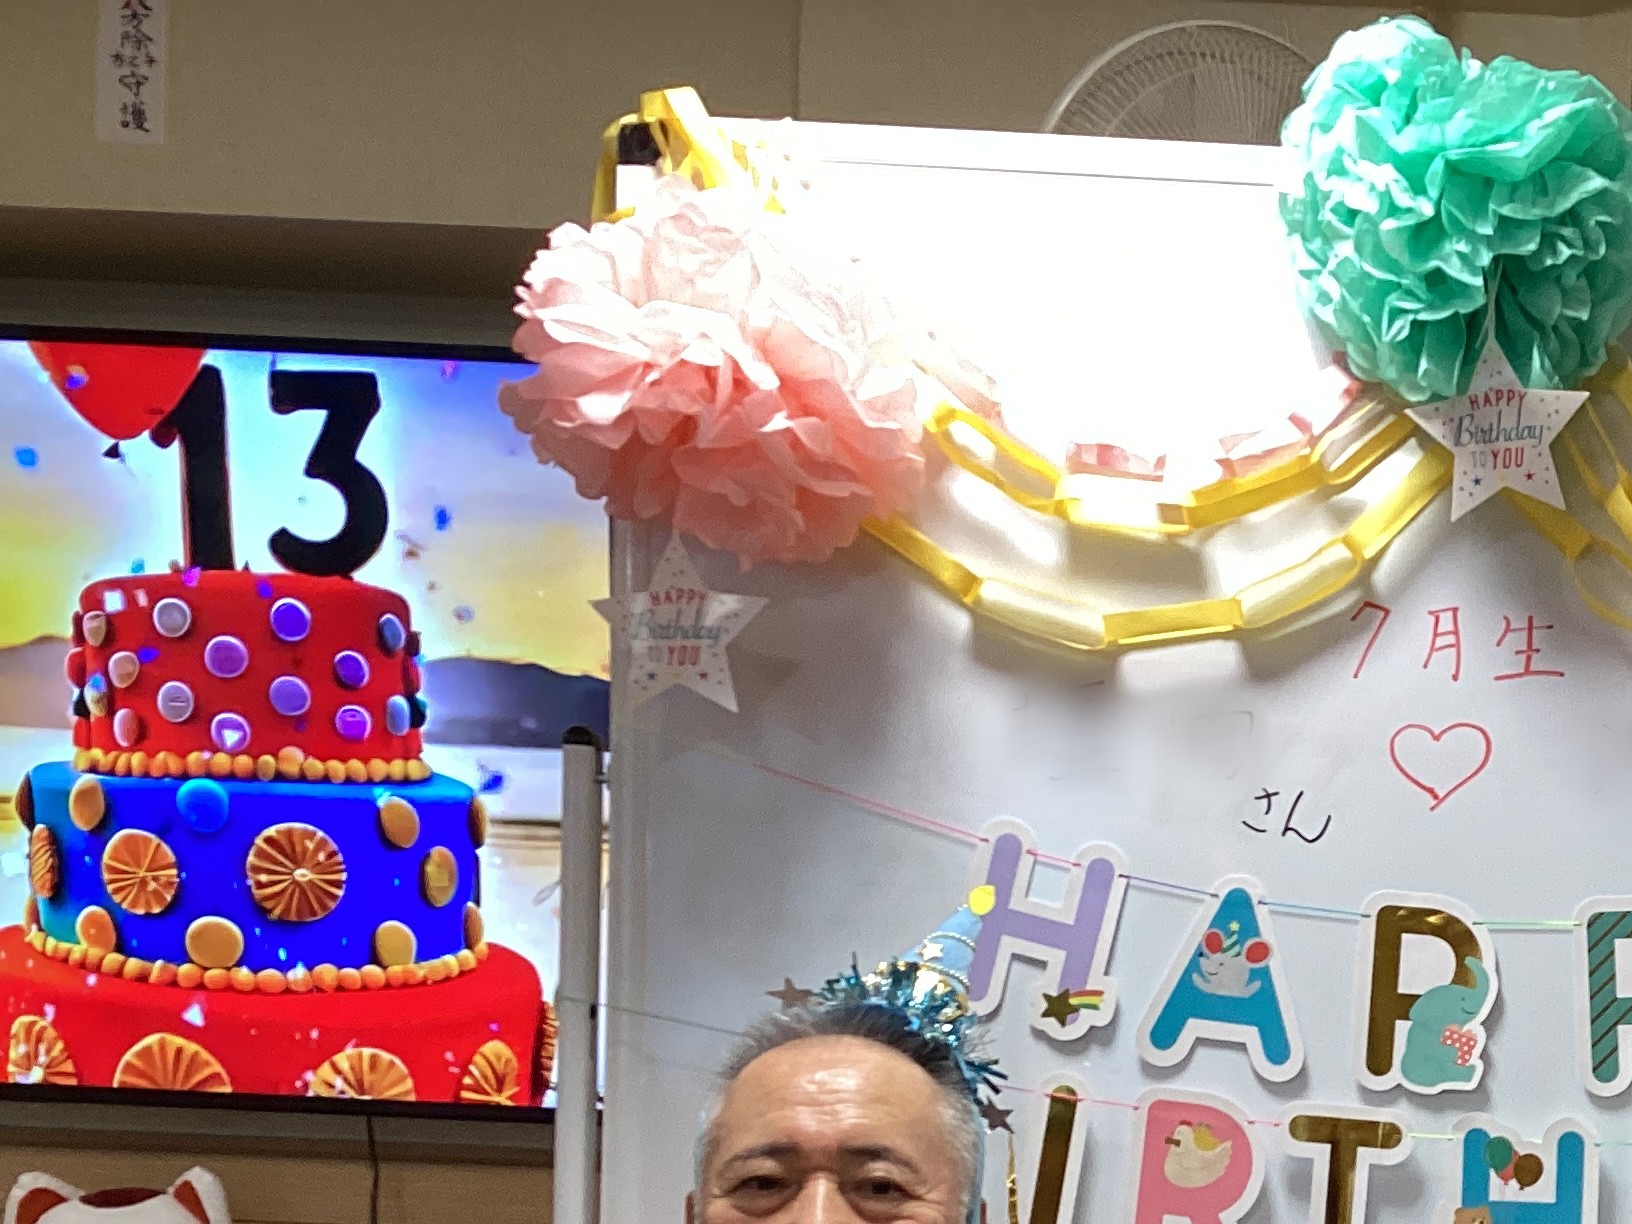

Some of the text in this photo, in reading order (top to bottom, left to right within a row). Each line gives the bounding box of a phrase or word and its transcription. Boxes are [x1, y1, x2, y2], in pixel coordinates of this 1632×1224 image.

[1468, 389, 1528, 412] HAPPY
[1454, 408, 1544, 449] Birthday
[150, 363, 389, 577] 13
[1471, 447, 1525, 470] TO YOU
[650, 587, 711, 608] HAPPY
[631, 607, 728, 648] Birthday
[666, 645, 700, 667] YOU
[1242, 787, 1332, 844] さん
